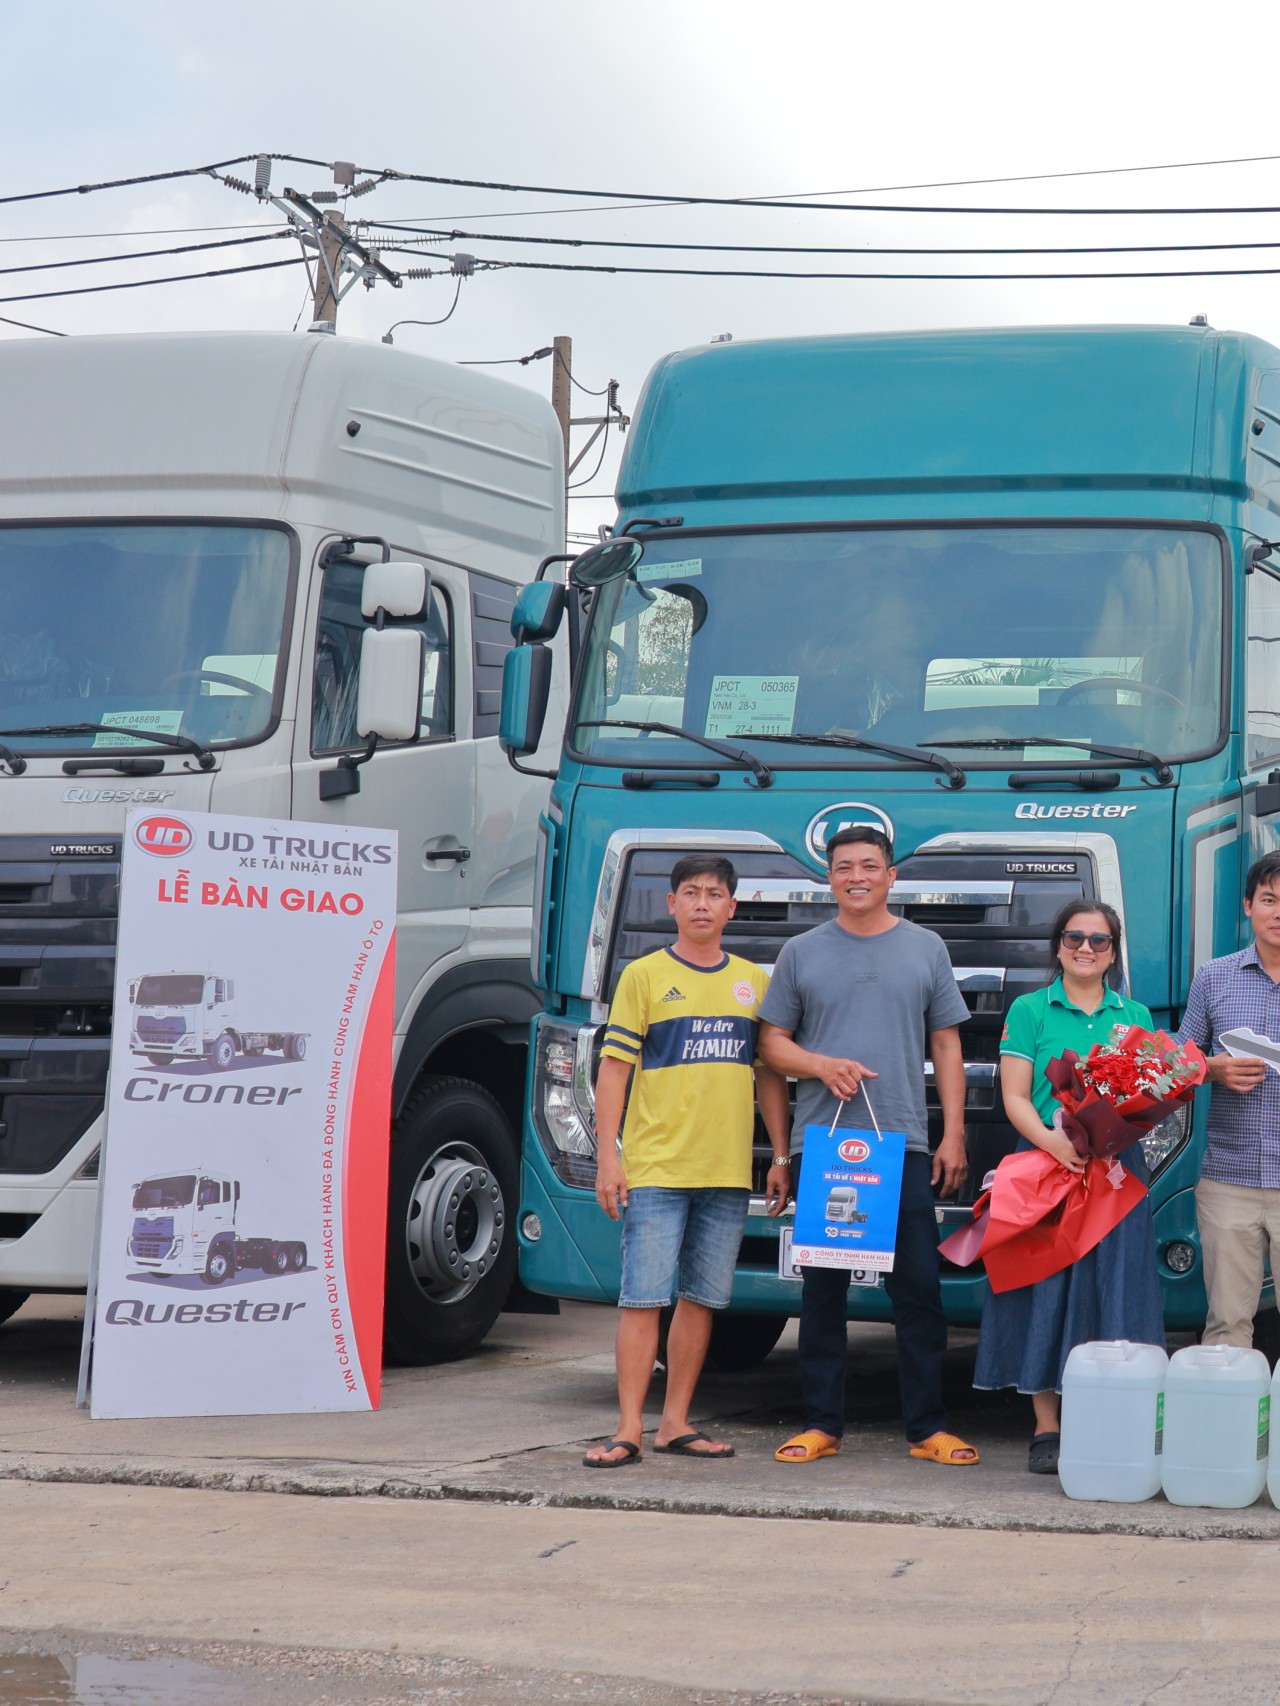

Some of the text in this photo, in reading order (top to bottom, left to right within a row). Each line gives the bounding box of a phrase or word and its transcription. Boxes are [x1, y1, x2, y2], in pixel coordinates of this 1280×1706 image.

[714, 681, 795, 692] JPCT 050365
[712, 701, 756, 710] VNM 28-3
[104, 716, 160, 725] JPCT 048698
[708, 724, 718, 733] T1
[735, 725, 752, 734] 27-4
[61, 787, 176, 804] Quester
[1014, 802, 1136, 820] Quester
[50, 845, 114, 855] UD TRUCKS
[208, 830, 254, 852] UD
[262, 835, 392, 865] TRUCKS
[238, 856, 363, 876] XE TẢI NHẬT BẢN
[1006, 863, 1076, 873] UD TRUCKS
[158, 868, 364, 916] LỄ BÀN GIAO
[368, 919, 384, 937] TÔ
[362, 939, 374, 950] Ô
[351, 952, 369, 981] HÀN
[342, 983, 359, 1014] NAM
[662, 994, 686, 1002] adidas
[334, 1017, 350, 1056] CÙNG
[692, 1020, 734, 1033] We Are
[682, 1038, 746, 1060] FAMILY
[328, 1061, 342, 1100] HÀNH
[124, 1078, 302, 1106] Croner
[321, 1149, 334, 1170] ĐÃ
[321, 1173, 332, 1214] HÀNG
[321, 1218, 335, 1270] KHÁCH
[814, 1249, 834, 1257] CÔNG
[326, 1274, 338, 1304] QUÝ
[104, 1300, 306, 1326] Quester
[330, 1308, 343, 1330] ƠN
[342, 1368, 358, 1393] XIN
